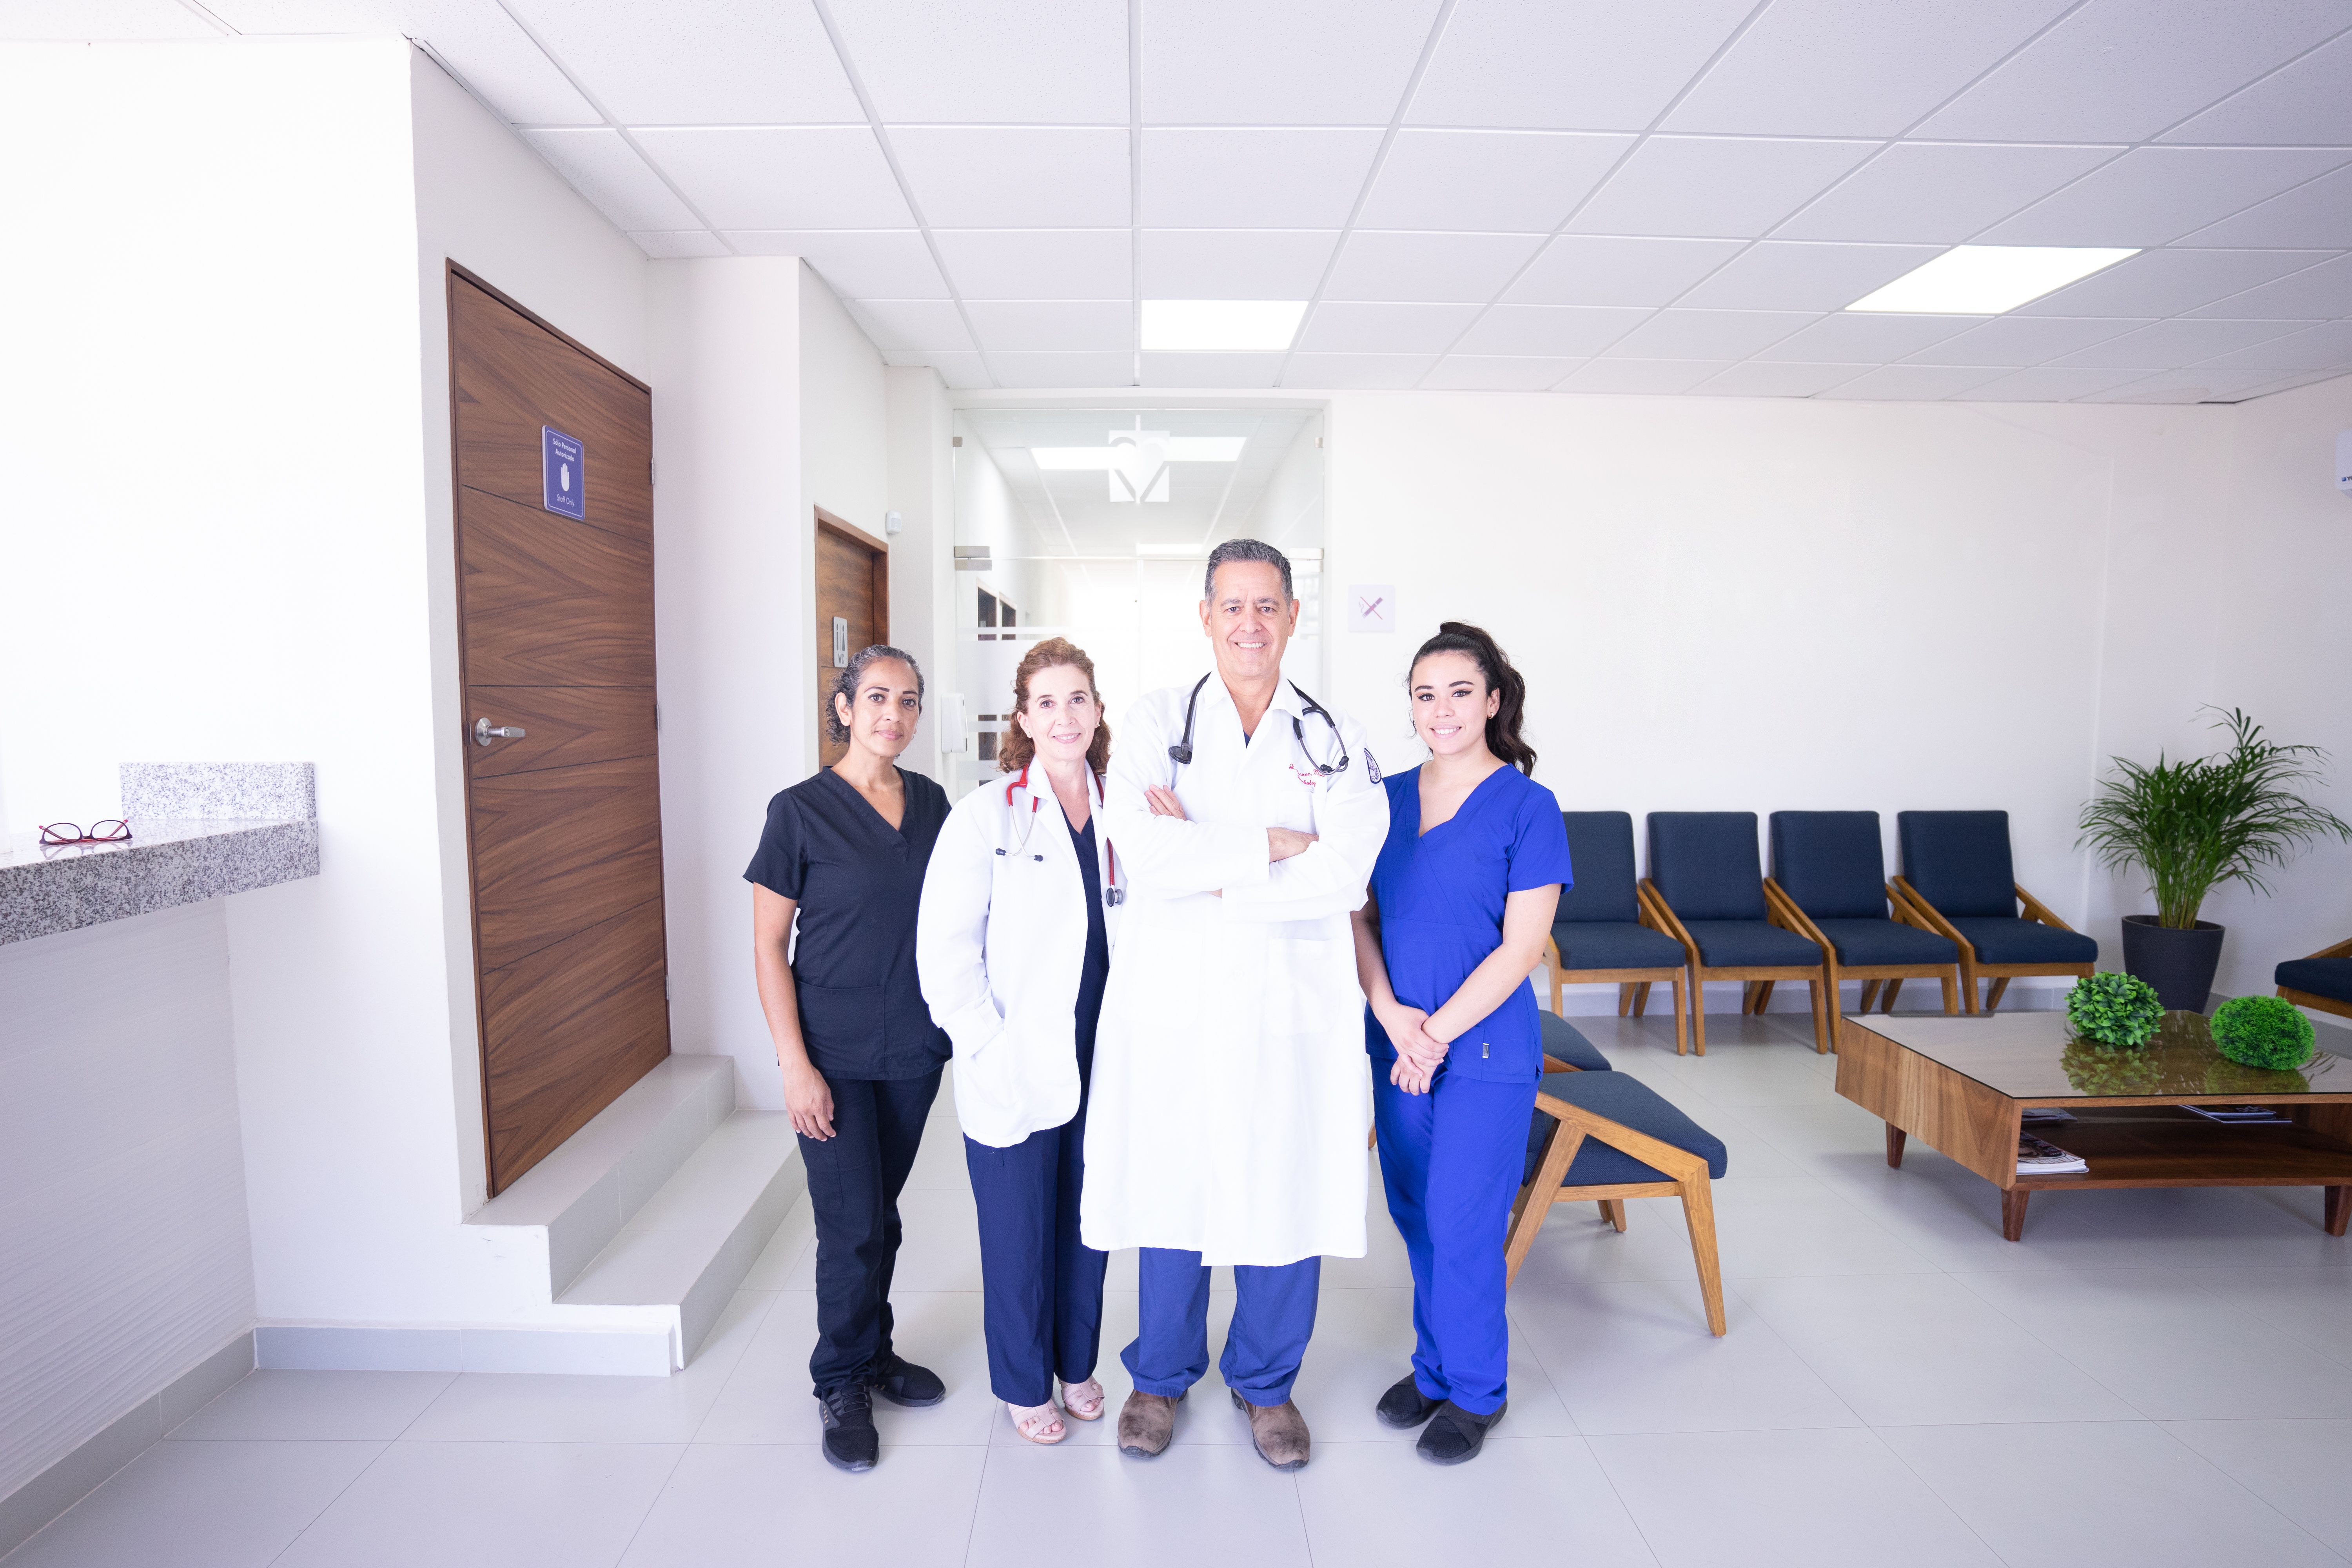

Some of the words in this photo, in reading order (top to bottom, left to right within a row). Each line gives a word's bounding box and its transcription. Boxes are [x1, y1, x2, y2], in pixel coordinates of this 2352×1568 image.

[553, 438, 561, 447] Sólo
[561, 442, 576, 454] Personal
[555, 448, 575, 462] Autorizado
[557, 494, 566, 503] Staff
[566, 497, 575, 508] Only
[838, 653, 844, 664] WC
